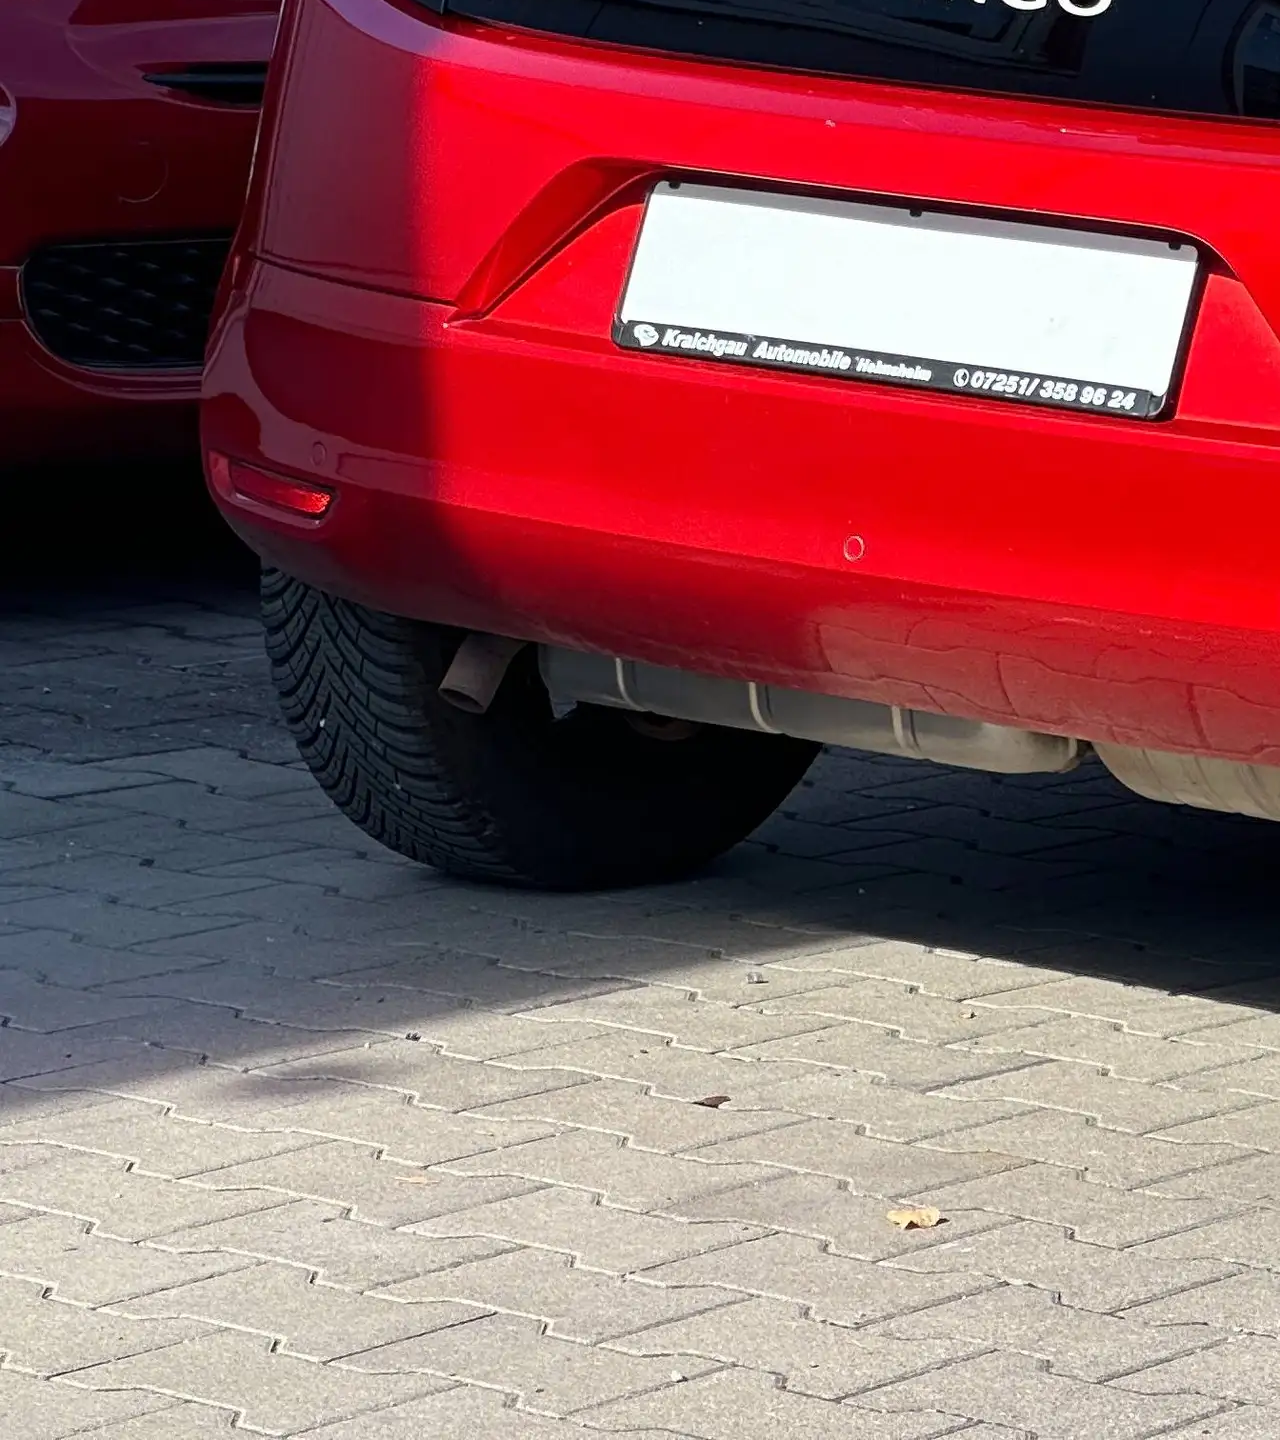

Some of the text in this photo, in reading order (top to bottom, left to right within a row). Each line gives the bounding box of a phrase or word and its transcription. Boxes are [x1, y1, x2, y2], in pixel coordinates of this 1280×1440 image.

[661, 329, 748, 357] Kraichgau
[753, 341, 851, 370] Automobile
[970, 370, 1040, 397] 07251/
[1039, 380, 1079, 402] 358
[1079, 385, 1107, 406] 96
[1107, 389, 1137, 410] 24
